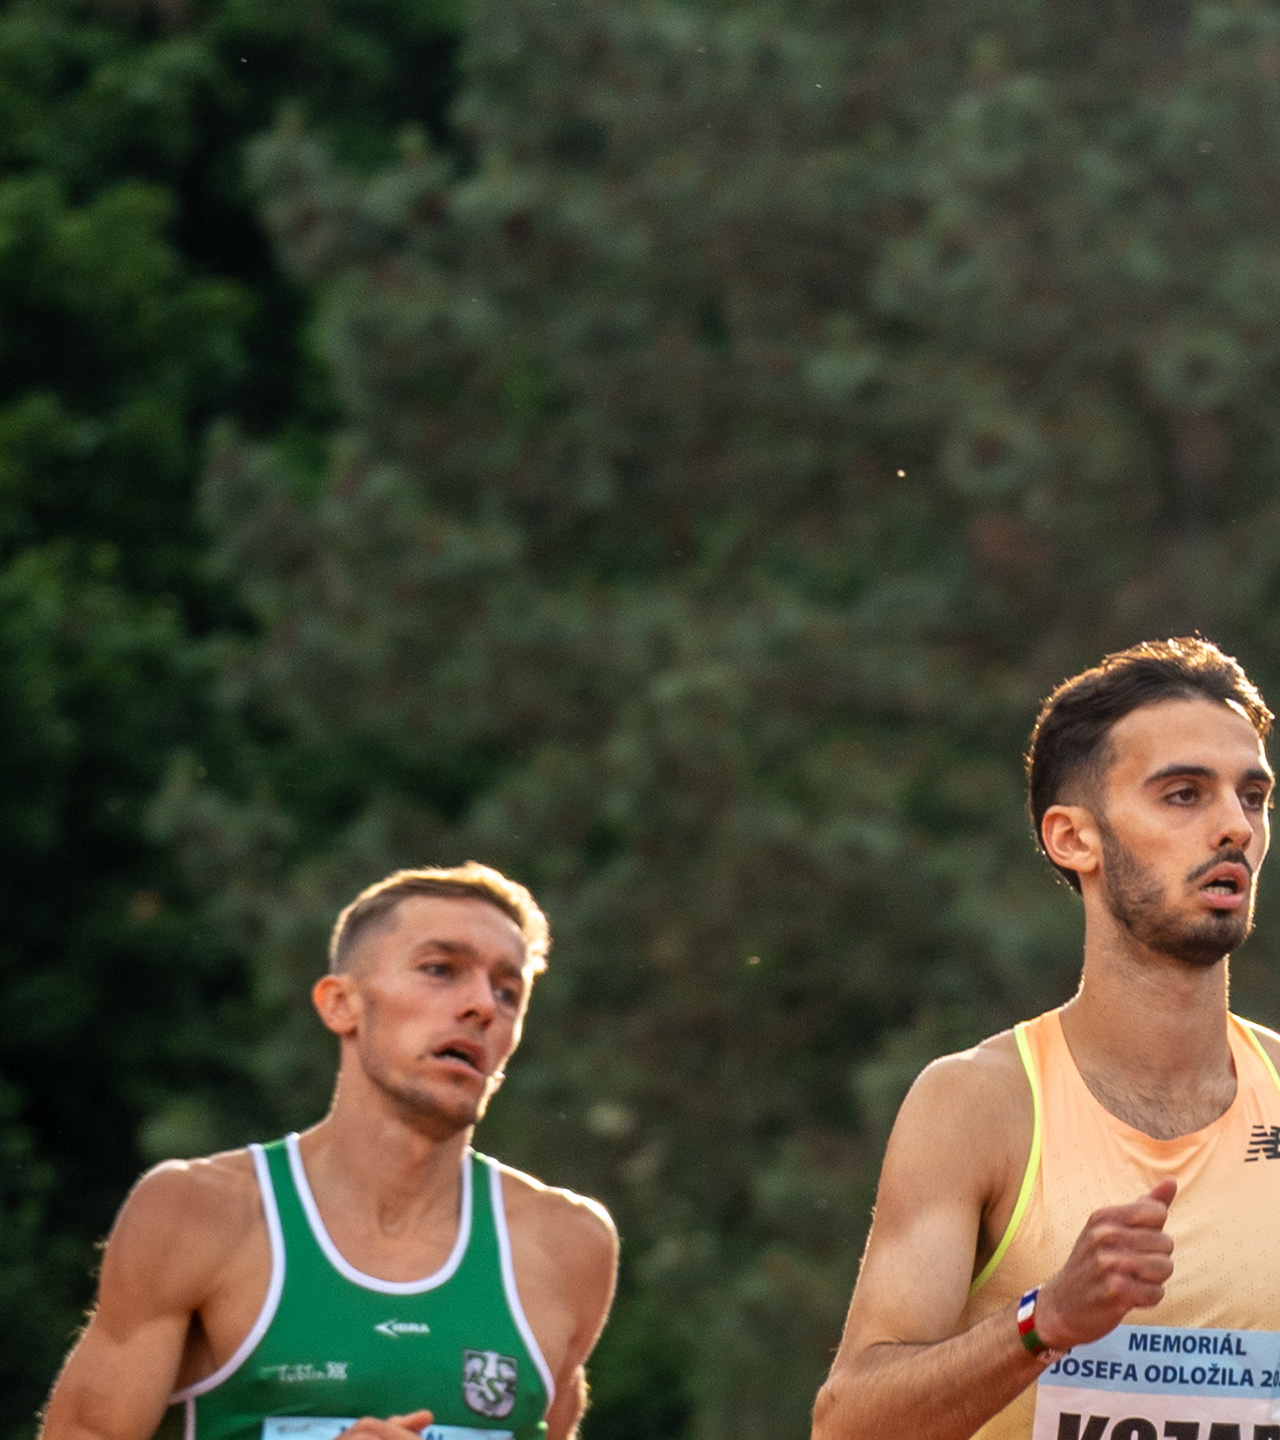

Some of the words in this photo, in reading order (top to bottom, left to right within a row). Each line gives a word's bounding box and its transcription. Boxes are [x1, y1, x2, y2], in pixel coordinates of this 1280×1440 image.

[1128, 1330, 1247, 1356] MEMORIÁL
[1050, 1358, 1138, 1382] JOSEFA
[1144, 1362, 1254, 1387] ODLOŽILA
